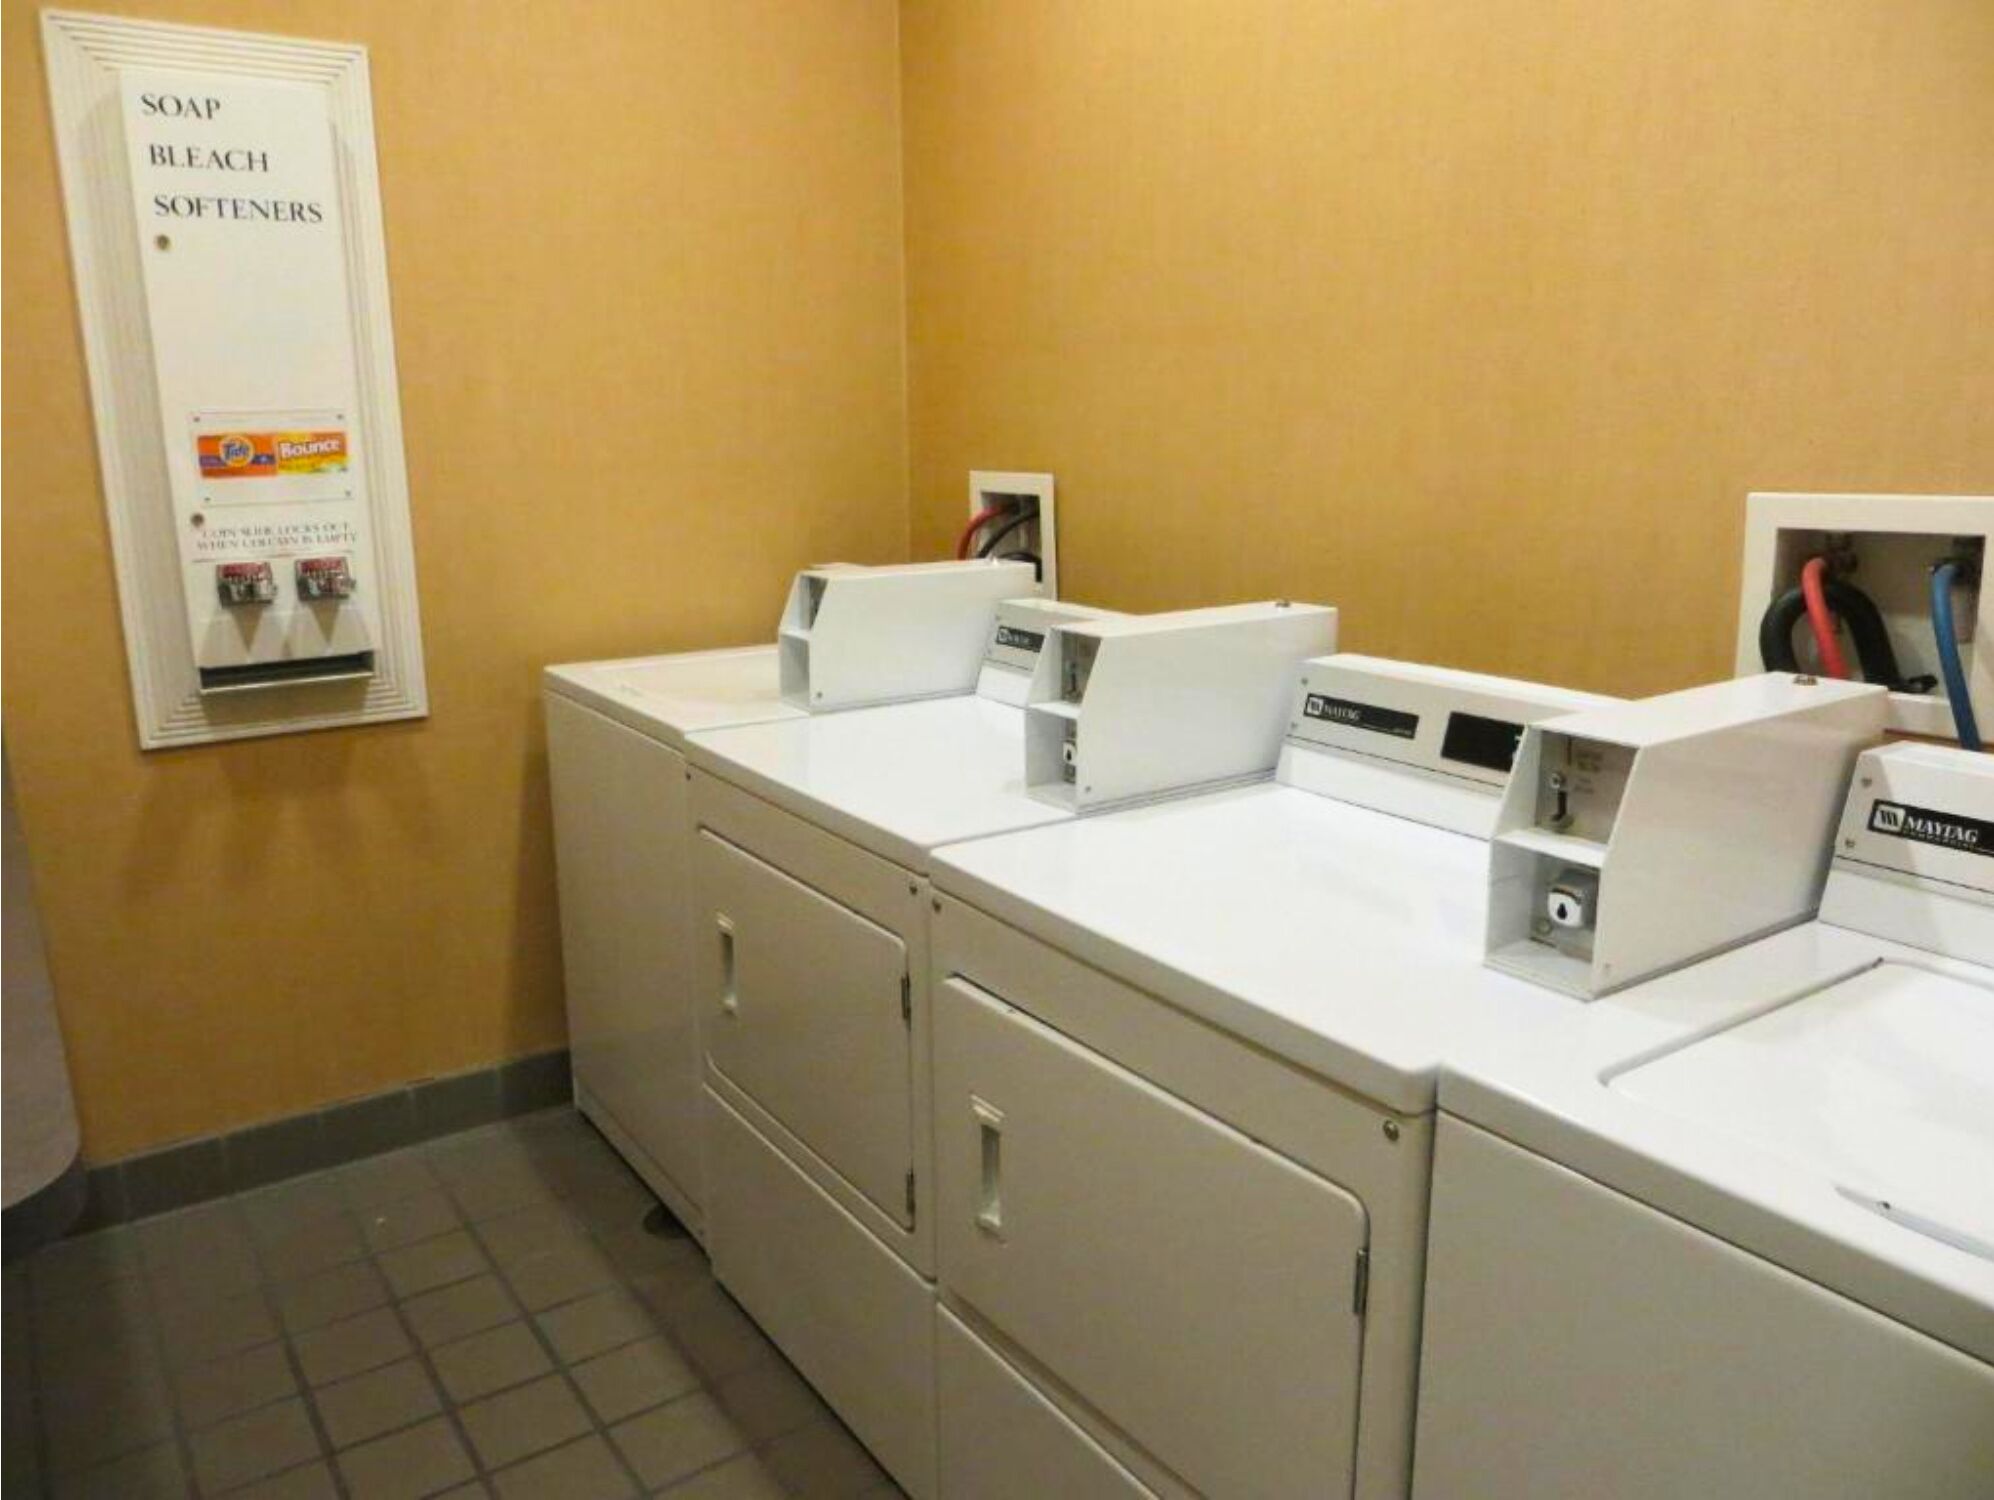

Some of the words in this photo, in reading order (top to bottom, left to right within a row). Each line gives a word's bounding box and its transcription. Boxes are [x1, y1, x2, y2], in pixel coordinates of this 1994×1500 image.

[141, 93, 221, 120] SOAP
[149, 143, 269, 172] BLEACH
[153, 194, 323, 223] SOFTENERS
[1904, 815, 1979, 843] MAYTAG
